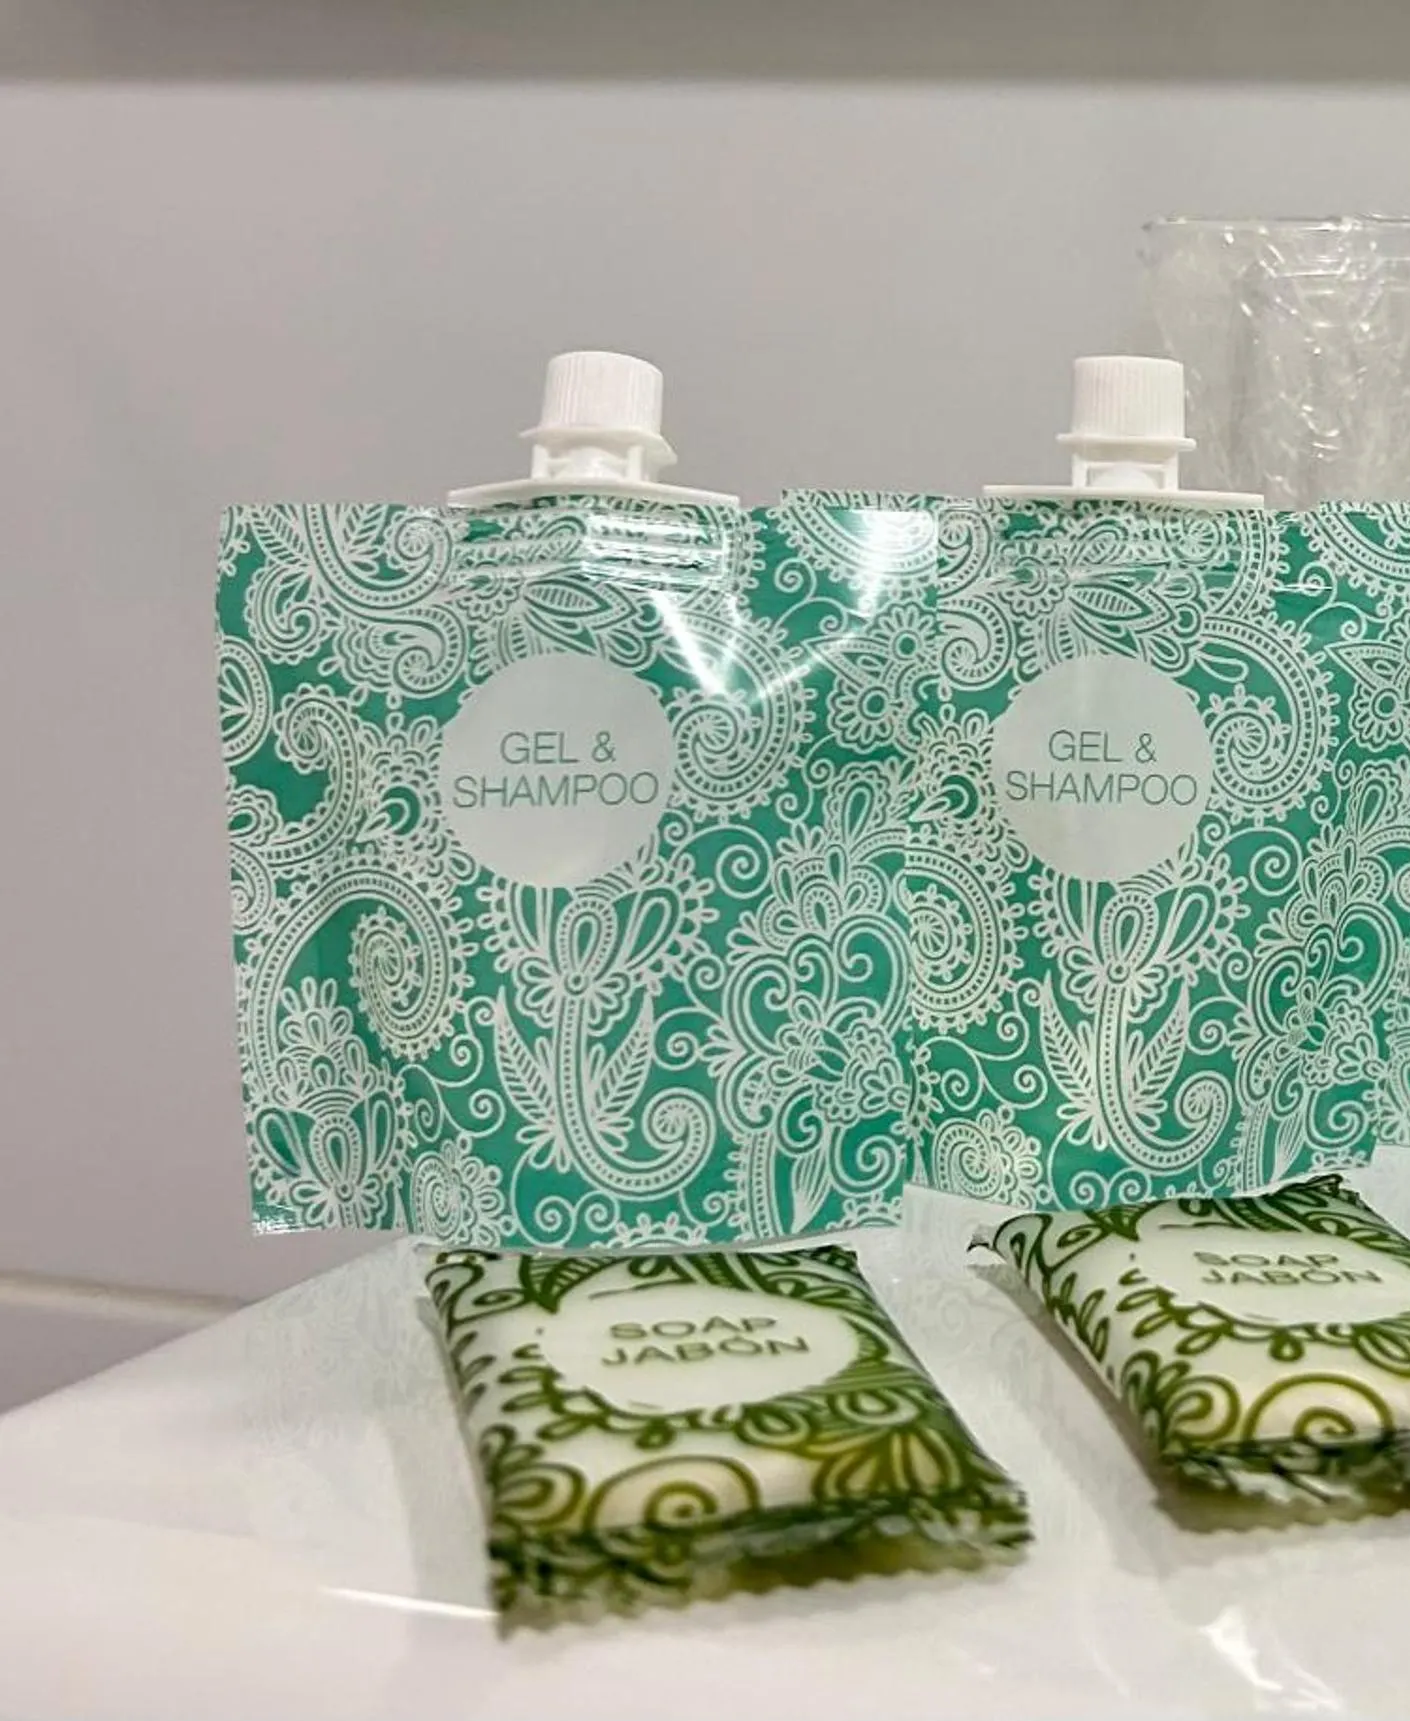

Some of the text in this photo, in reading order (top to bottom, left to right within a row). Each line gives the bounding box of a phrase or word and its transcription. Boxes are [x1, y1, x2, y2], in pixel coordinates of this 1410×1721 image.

[501, 731, 616, 764] GEL &
[1048, 729, 1157, 763] GEL &
[453, 771, 659, 808] SHAMPOO
[1005, 770, 1198, 805] SHAMPOO
[1194, 1251, 1340, 1267] SOAP
[609, 1316, 776, 1340] SOAP
